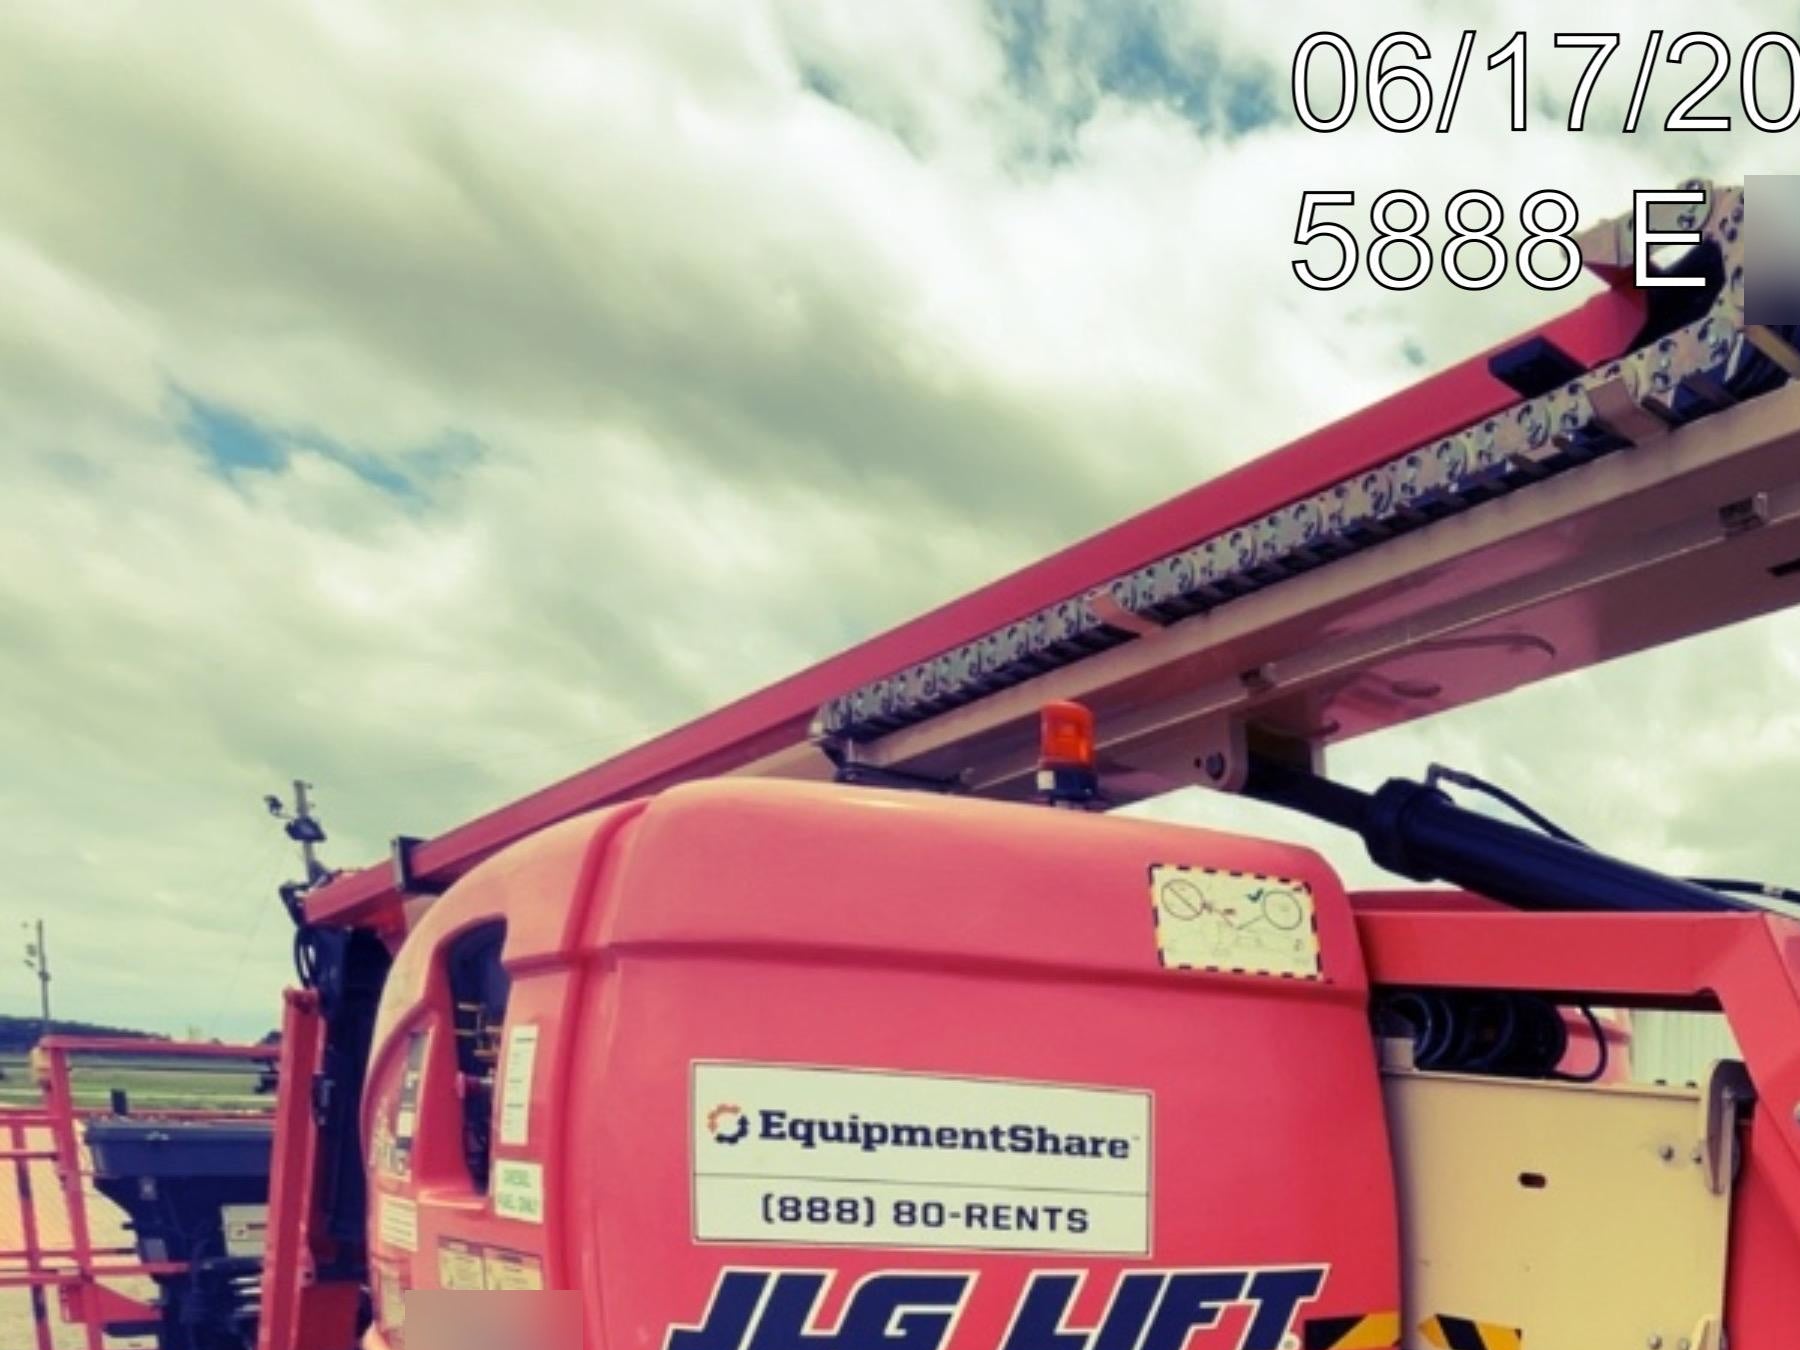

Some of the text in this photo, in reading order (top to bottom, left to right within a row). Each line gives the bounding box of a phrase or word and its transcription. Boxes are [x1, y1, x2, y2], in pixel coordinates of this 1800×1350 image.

[758, 1109, 1130, 1159] EquipmentShare
[761, 1193, 1090, 1234] (888) 80-RENTS
